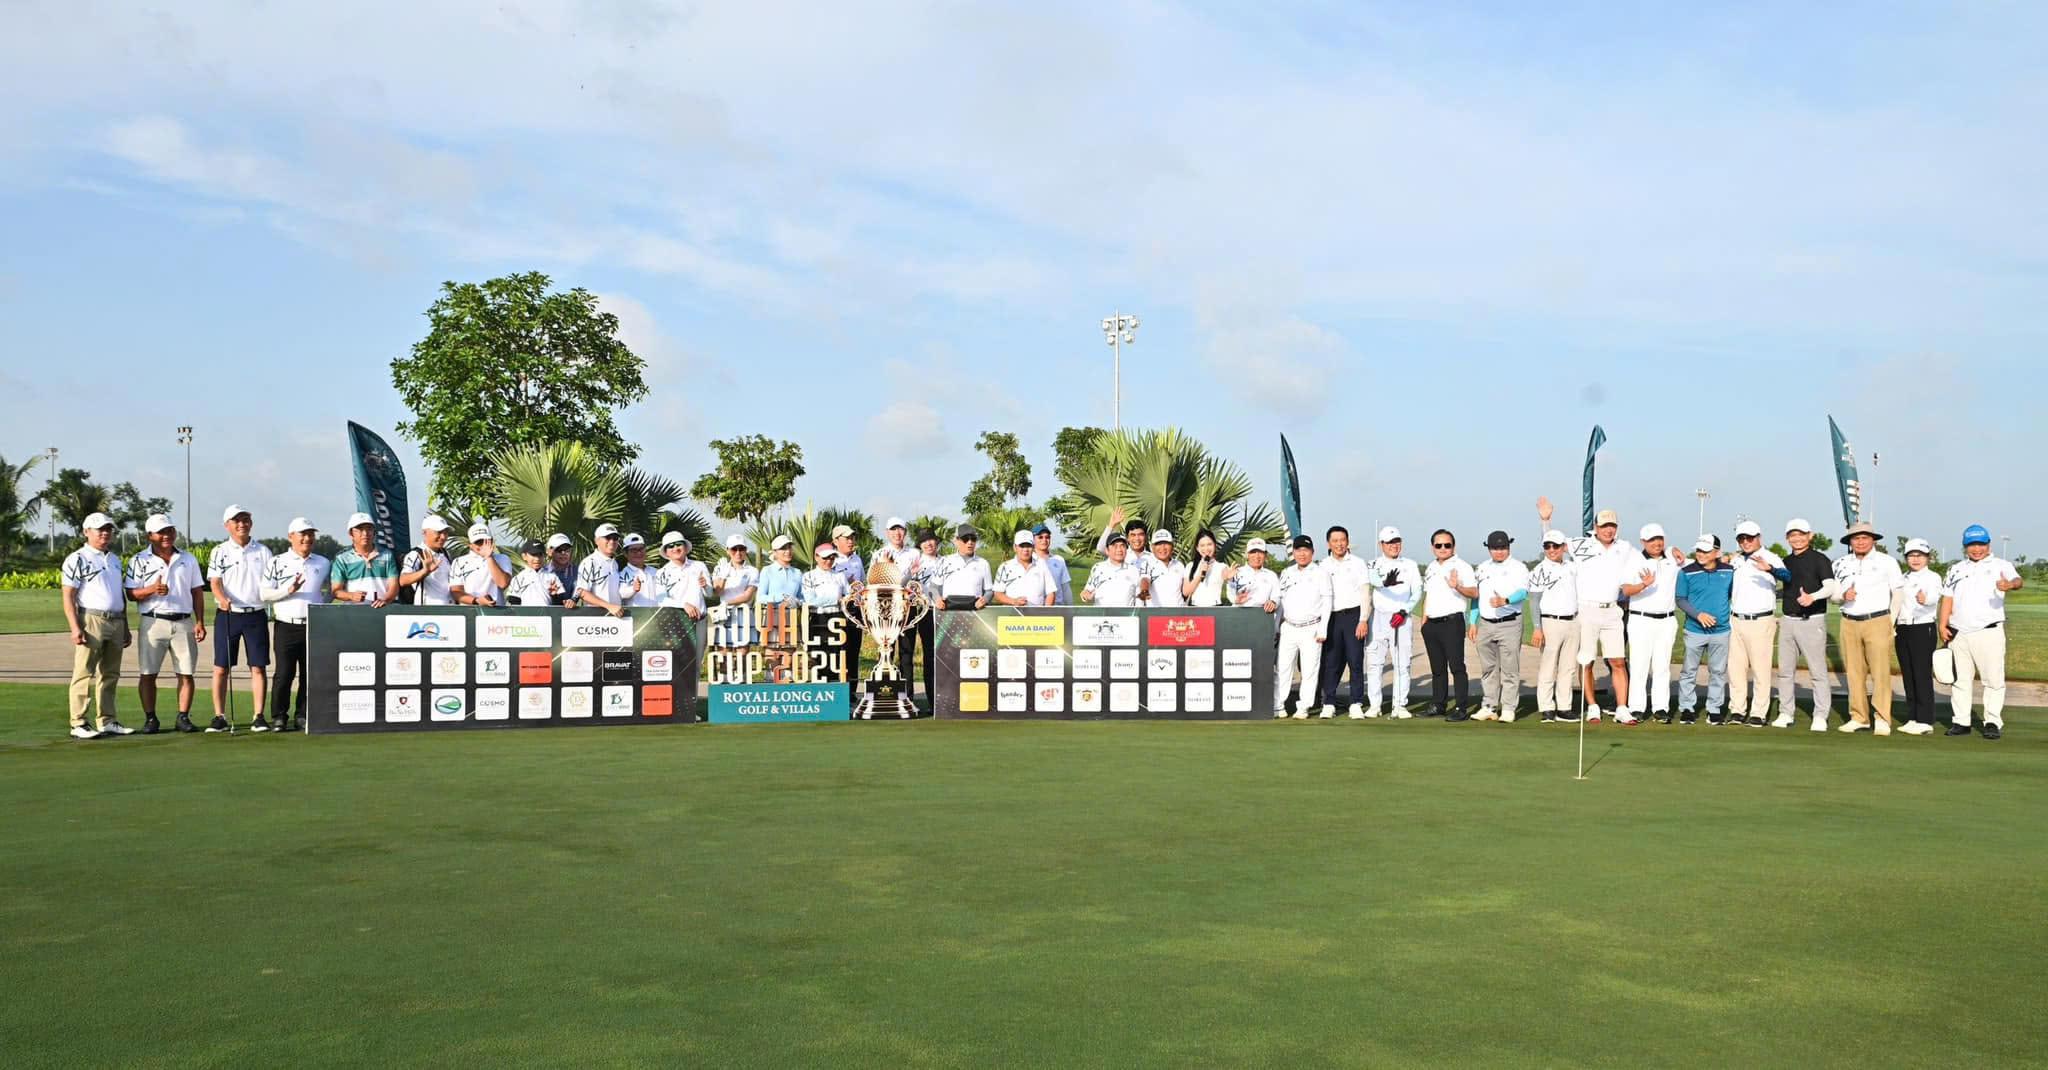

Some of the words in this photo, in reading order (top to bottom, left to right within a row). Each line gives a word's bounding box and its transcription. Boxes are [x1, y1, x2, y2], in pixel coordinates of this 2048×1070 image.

[577, 626, 619, 636] COSMO
[708, 651, 763, 684] CUP
[773, 650, 848, 684] 2024
[723, 691, 770, 703] ROYAL
[774, 691, 812, 702] LONG
[815, 690, 835, 702] AN
[738, 705, 769, 715] GOLF
[771, 705, 779, 714] &
[782, 704, 820, 714] VILLAS
